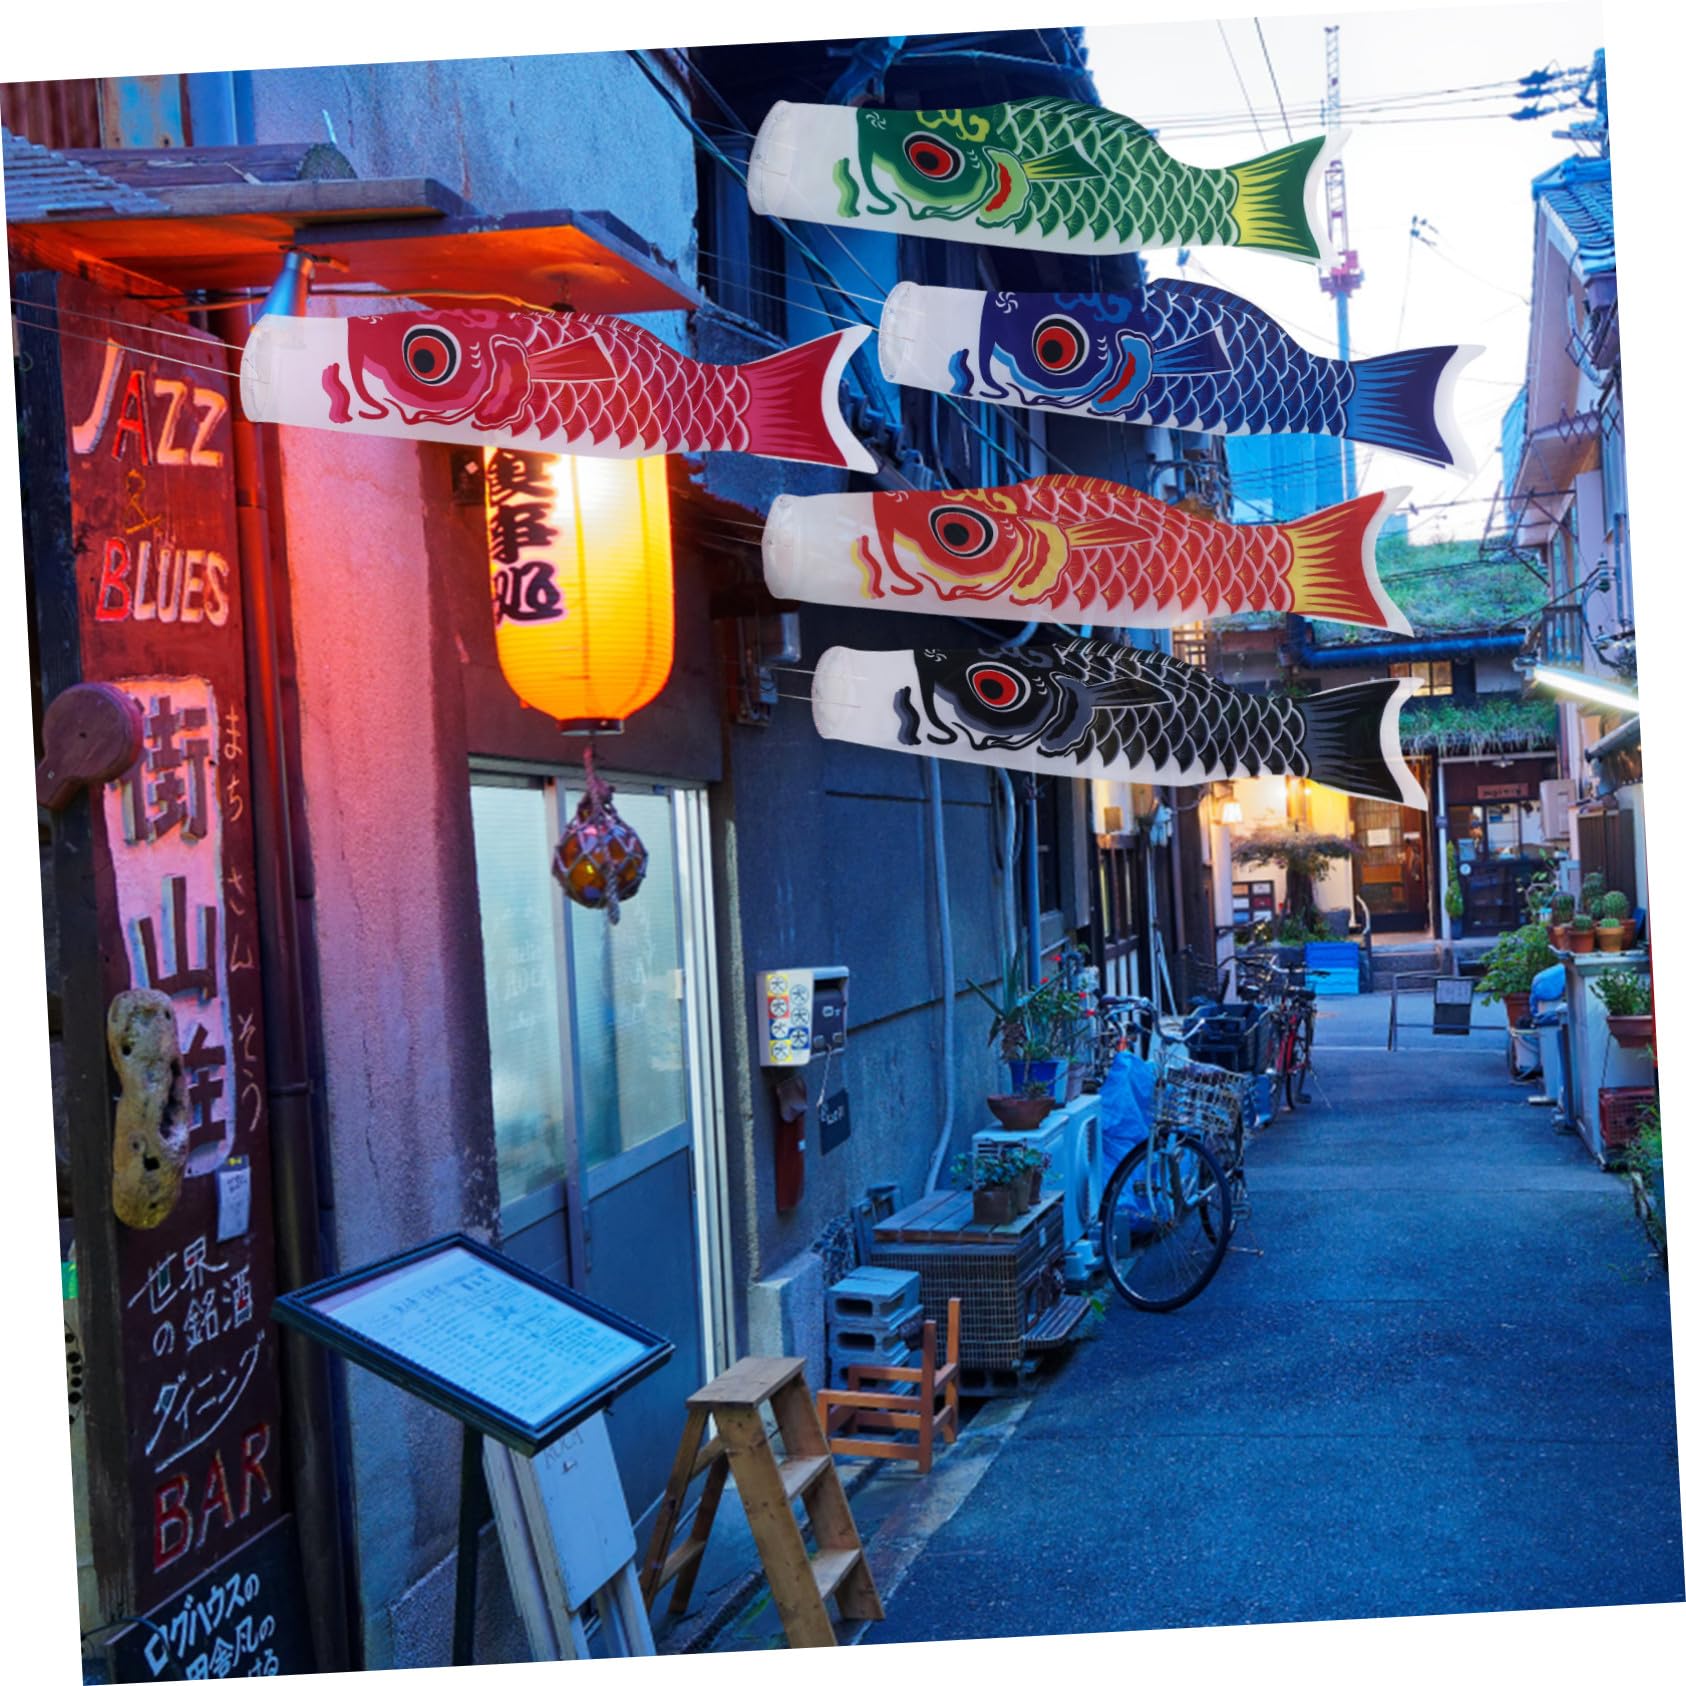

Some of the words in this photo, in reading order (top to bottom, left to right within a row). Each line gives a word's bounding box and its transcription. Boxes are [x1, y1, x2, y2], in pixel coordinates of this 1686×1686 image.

[72, 337, 227, 467] JAZZ
[95, 537, 229, 627] BLUES
[128, 1235, 229, 1314] 世界
[153, 1263, 253, 1356] の銘酒
[145, 1329, 265, 1474] ダイニング
[153, 1422, 272, 1573] BAR
[144, 1573, 260, 1677] ログハウスの
